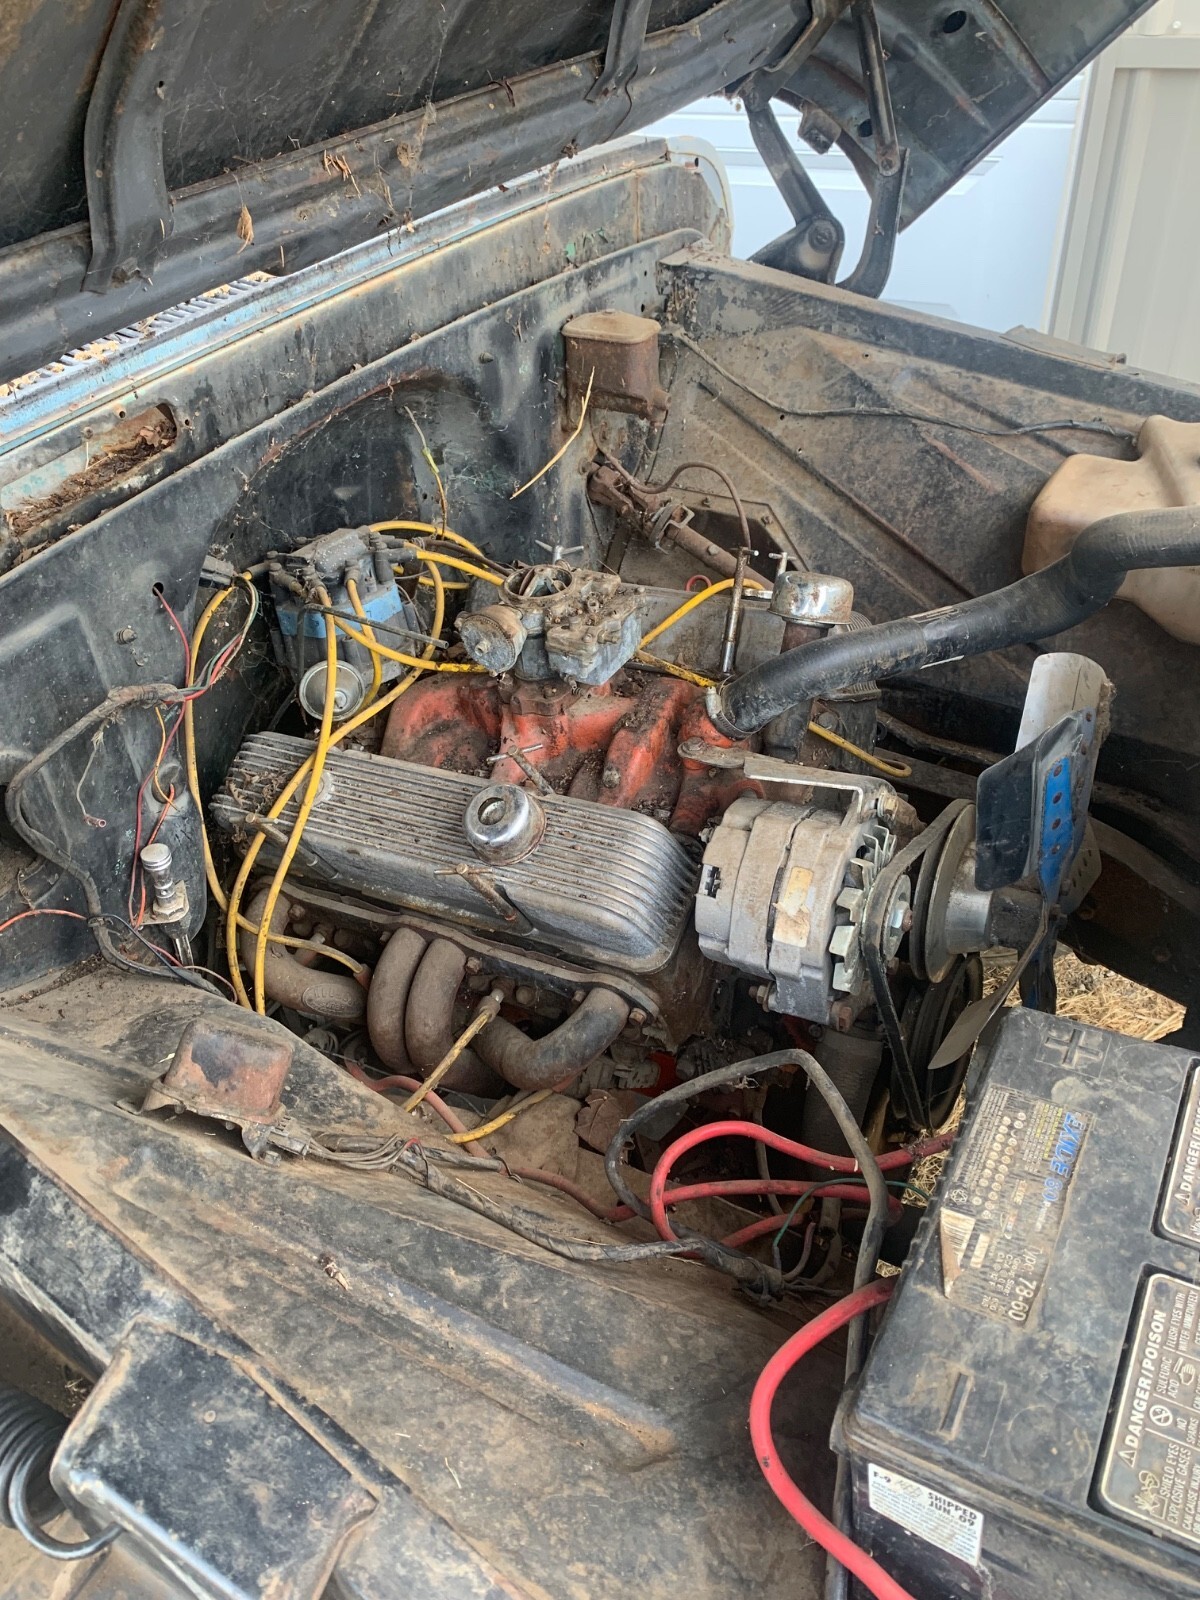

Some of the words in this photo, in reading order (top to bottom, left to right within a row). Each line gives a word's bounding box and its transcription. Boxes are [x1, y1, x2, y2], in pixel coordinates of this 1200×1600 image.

[1050, 1112, 1086, 1179] EXIDE
[1008, 1277, 1037, 1321] 78-60
[1175, 1292, 1186, 1309] WITH
[1183, 1290, 1198, 1330] IMMEDIATELY
[1171, 1309, 1182, 1326] EYES
[1166, 1326, 1178, 1348] FLUSH
[1178, 1329, 1190, 1351] WATER
[1125, 1309, 1167, 1448] DANGER/POISON
[1156, 1356, 1173, 1394] SULFURIC
[1168, 1379, 1179, 1398] ACID
[1176, 1417, 1187, 1431] NO
[1186, 1417, 1199, 1444] SPARKS
[1166, 1443, 1180, 1465] EYES
[1160, 1466, 1175, 1498] SHIELD
[1167, 1477, 1186, 1525] EXPLOSIVE
[1177, 1447, 1191, 1476] GASES
[928, 1491, 978, 1520] SHIPPED
[958, 1515, 975, 1527] 09
